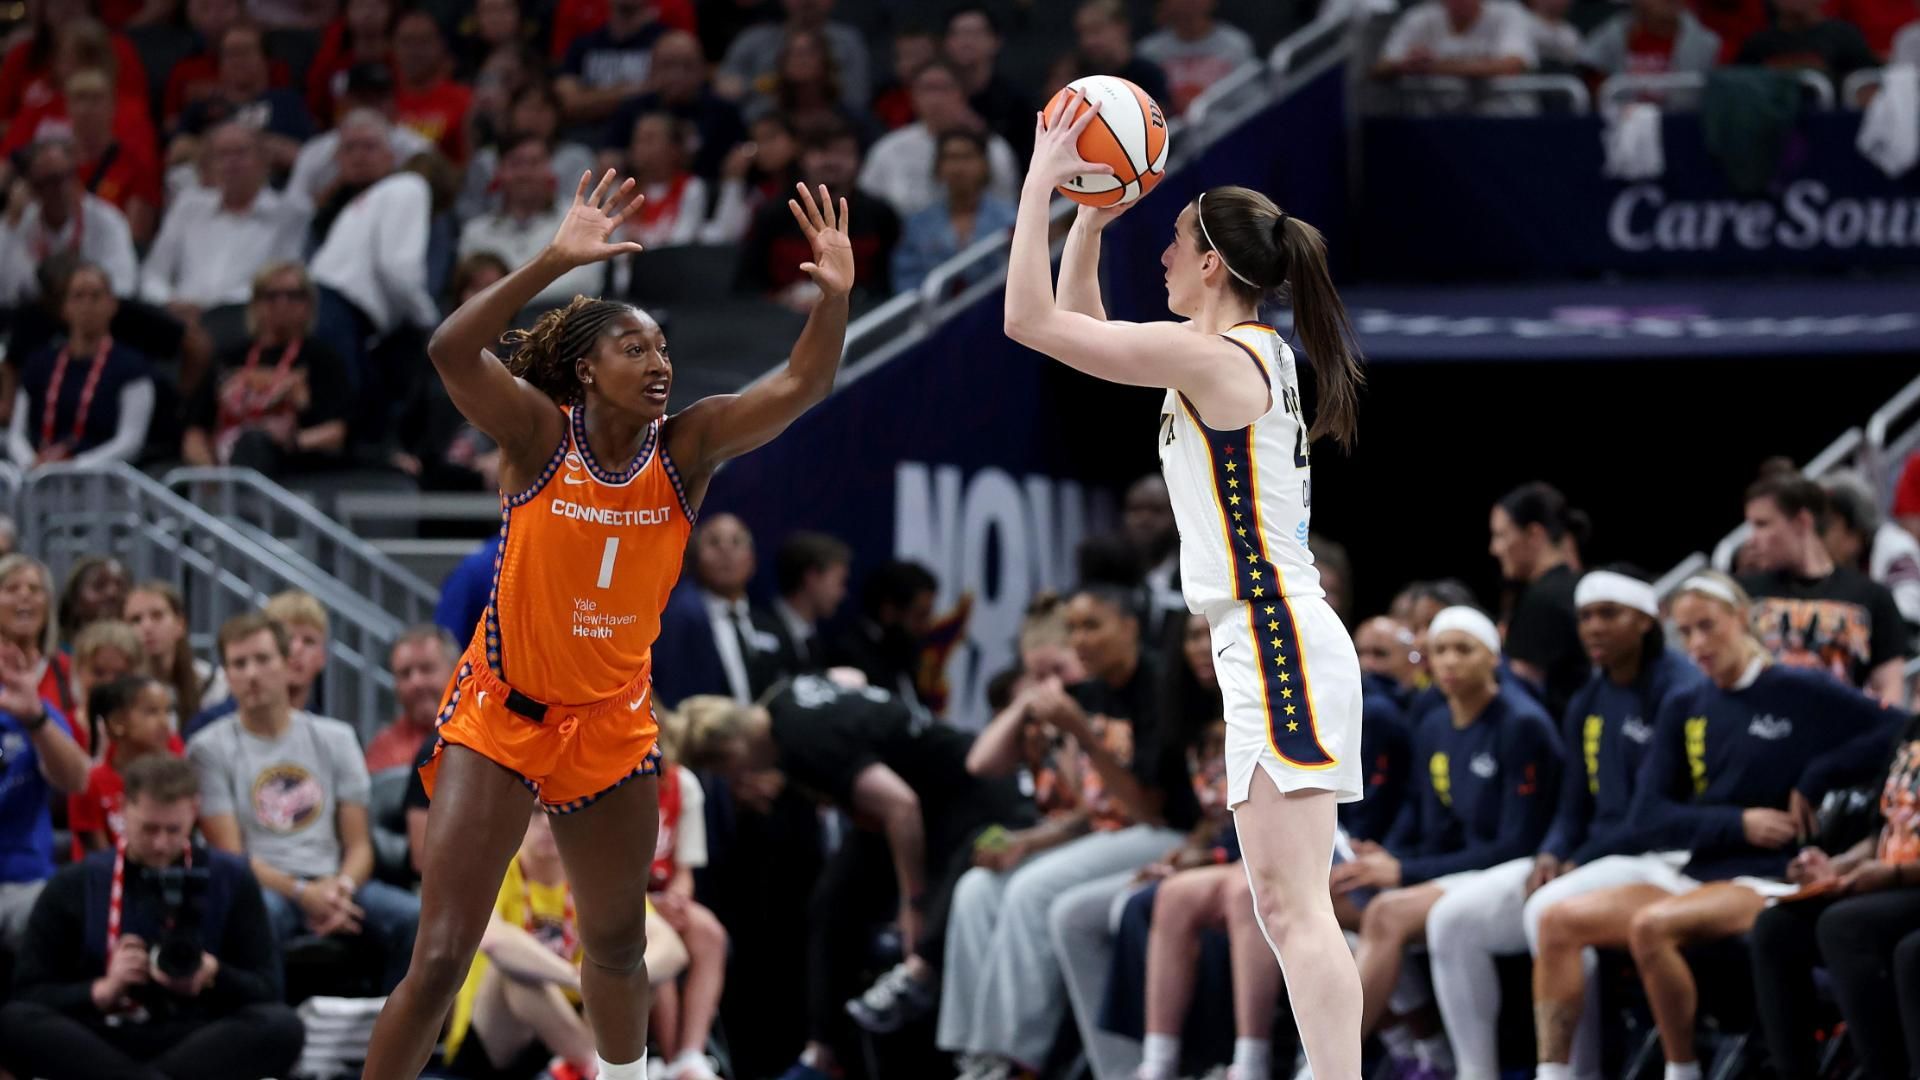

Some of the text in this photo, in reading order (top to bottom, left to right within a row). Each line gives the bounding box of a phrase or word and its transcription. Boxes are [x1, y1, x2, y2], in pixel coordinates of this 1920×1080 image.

[551, 498, 671, 526] CONNECTICUT
[596, 537, 620, 589] 1
[573, 597, 597, 611] Yale
[573, 624, 614, 639] Health
